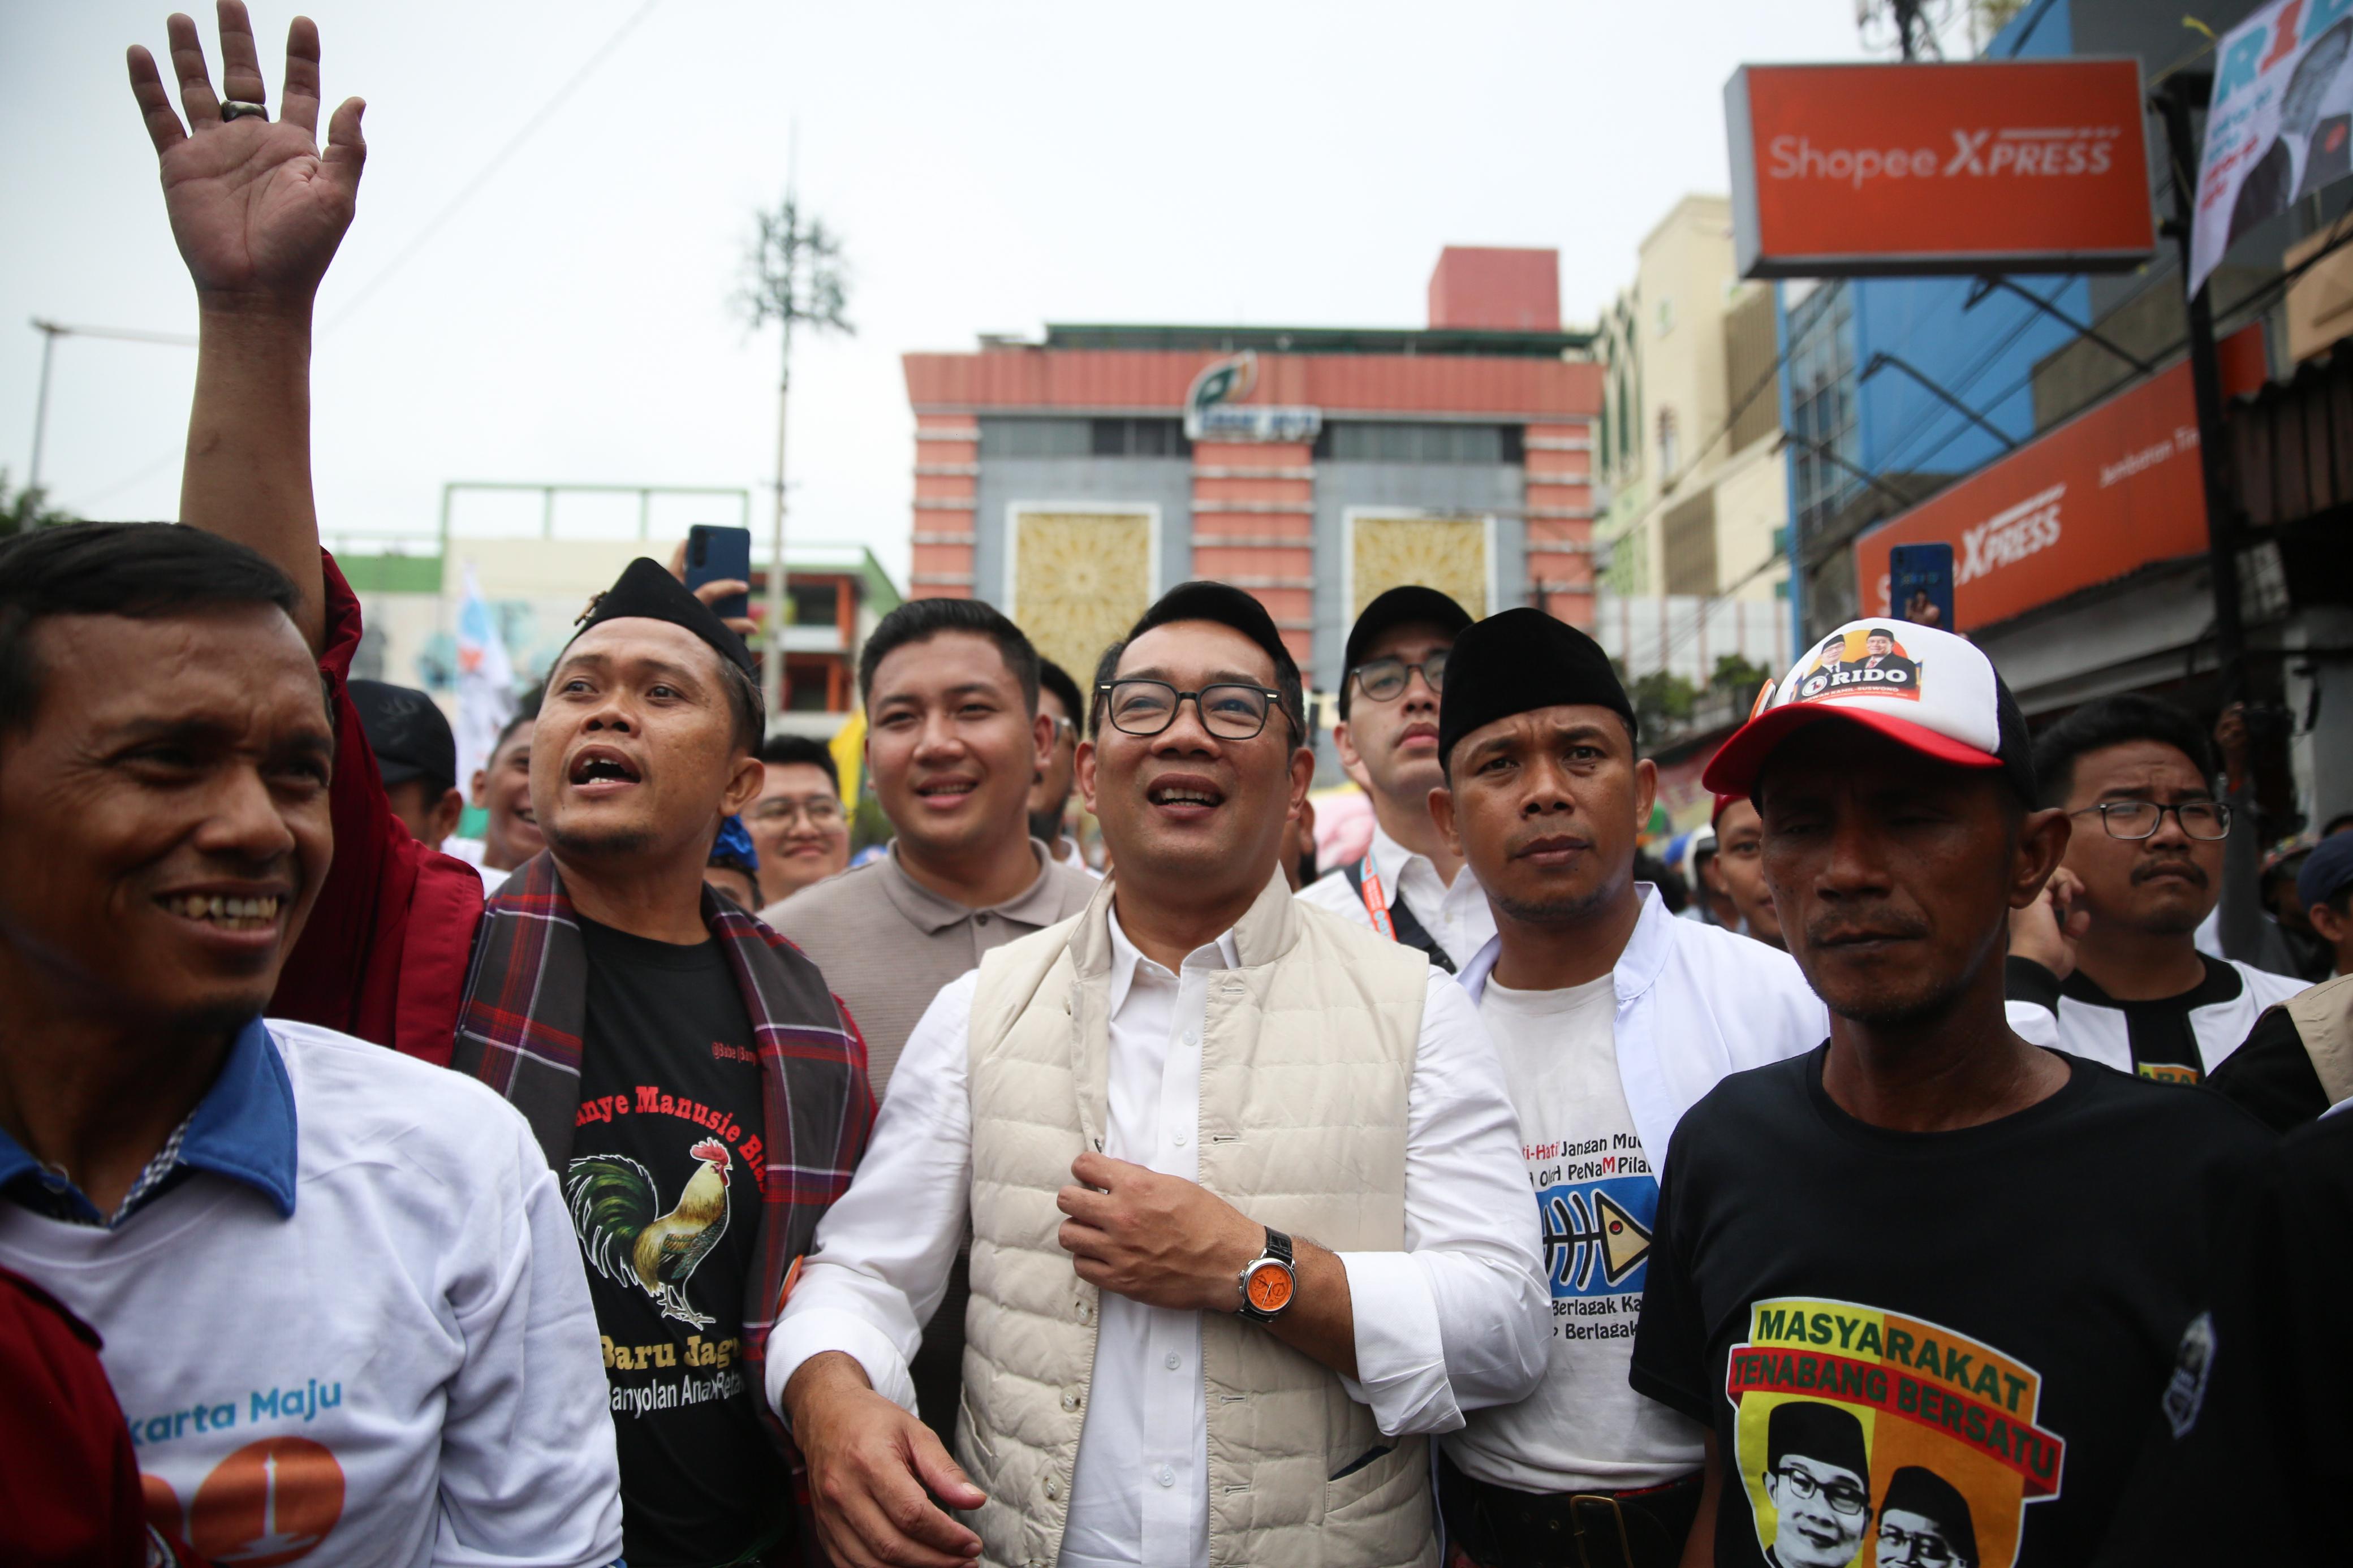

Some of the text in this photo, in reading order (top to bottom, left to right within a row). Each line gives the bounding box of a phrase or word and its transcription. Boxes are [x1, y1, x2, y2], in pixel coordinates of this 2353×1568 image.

[1769, 129, 2114, 189] Shopee XPRESS
[1957, 504, 2061, 586] XPRESS
[1831, 669, 1907, 686] RIDO
[635, 1086, 742, 1142] Manusie
[1562, 1138, 1607, 1157] Jangan
[1568, 1157, 1615, 1181] PeNaM
[1552, 1297, 1617, 1316] Berlagak
[601, 1335, 676, 1370] Baru
[1757, 1310, 2028, 1413] MASYARAKAT
[249, 1379, 341, 1423] Maju
[1733, 1355, 2055, 1479] TENABANG BERSATU
